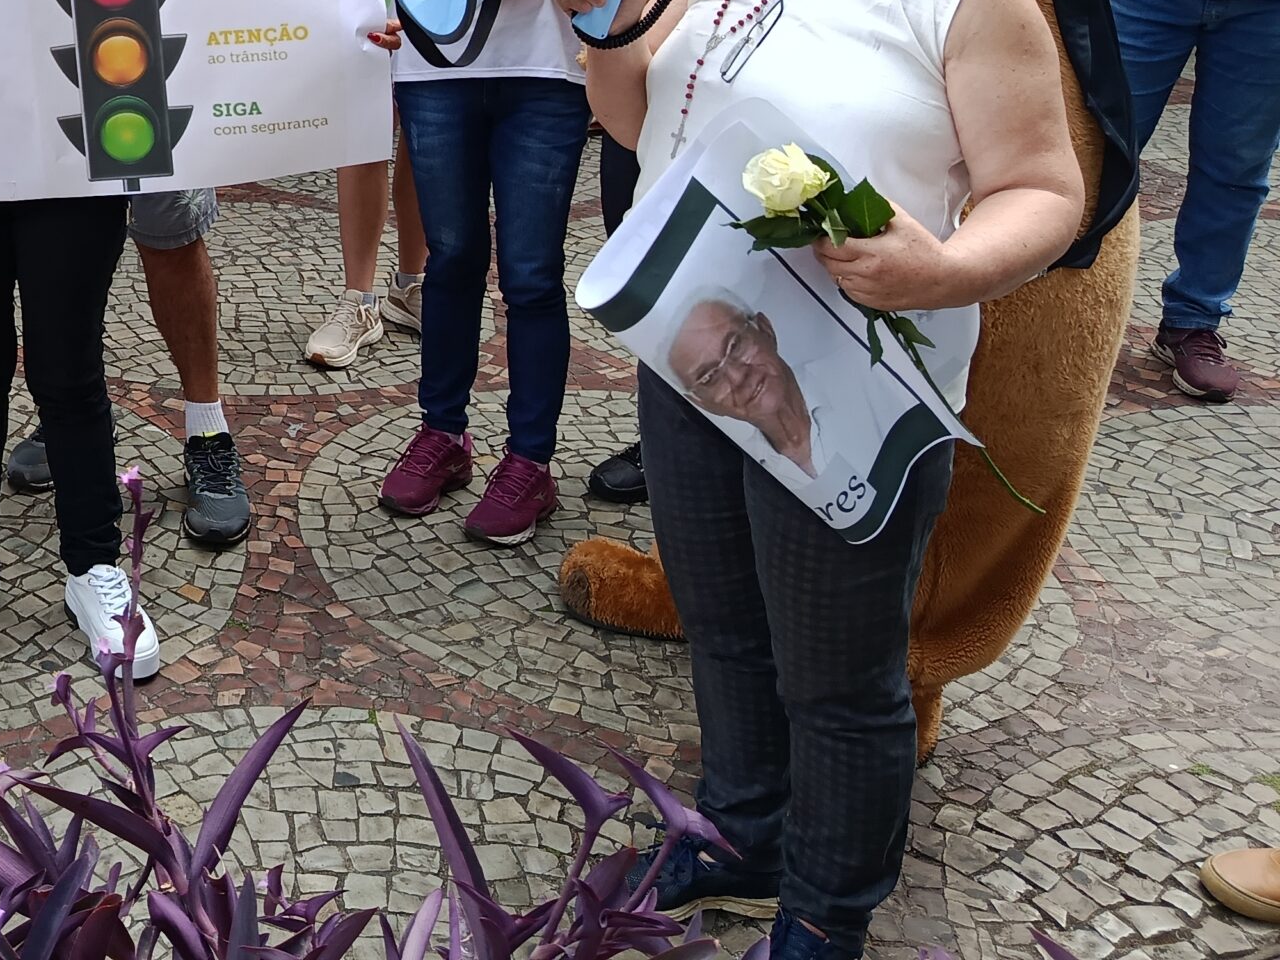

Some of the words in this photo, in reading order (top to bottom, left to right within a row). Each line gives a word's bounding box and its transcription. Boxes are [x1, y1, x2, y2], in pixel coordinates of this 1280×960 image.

[206, 23, 309, 46] ATENÇÃO
[208, 53, 226, 65] ao
[230, 49, 288, 64] trânsito
[212, 101, 262, 118] SIGA
[213, 123, 247, 136] com
[251, 116, 329, 135] segurança
